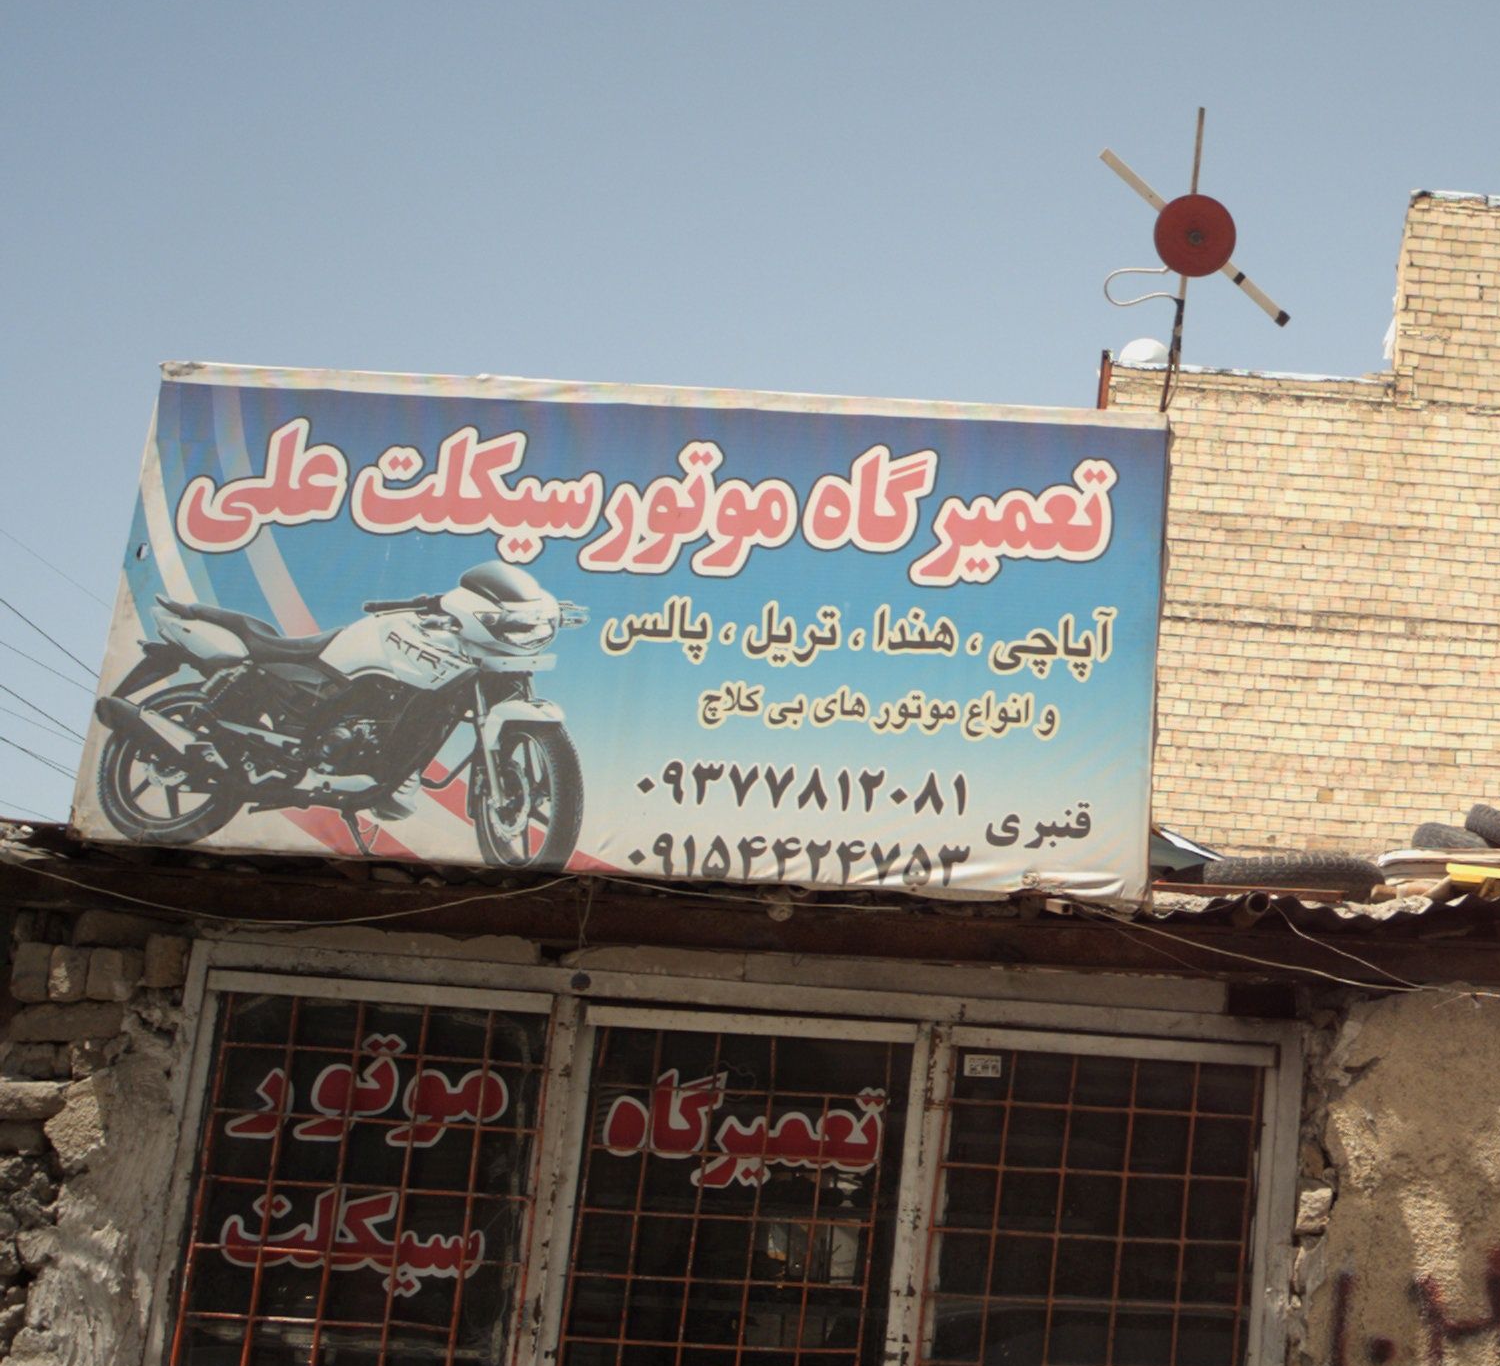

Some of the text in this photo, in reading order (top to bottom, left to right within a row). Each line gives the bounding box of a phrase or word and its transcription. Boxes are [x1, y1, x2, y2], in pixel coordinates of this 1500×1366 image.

[177, 418, 349, 553] علی
[602, 596, 712, 663] پالس
[698, 681, 764, 726] کلاچ
[767, 690, 807, 728] بی
[964, 691, 1034, 740] انواع
[1037, 705, 1060, 738] و
[636, 760, 968, 817] ۰۹۳۷۷۸۱۲۰۸۱
[986, 803, 1092, 849] قنبری
[627, 833, 971, 888] ۰۹۱۵۴۴۲۴۷۵۳
[225, 1034, 509, 1148] موتور
[603, 1068, 890, 1188] تعمیرگاه
[220, 1188, 485, 1297] سیکلت
